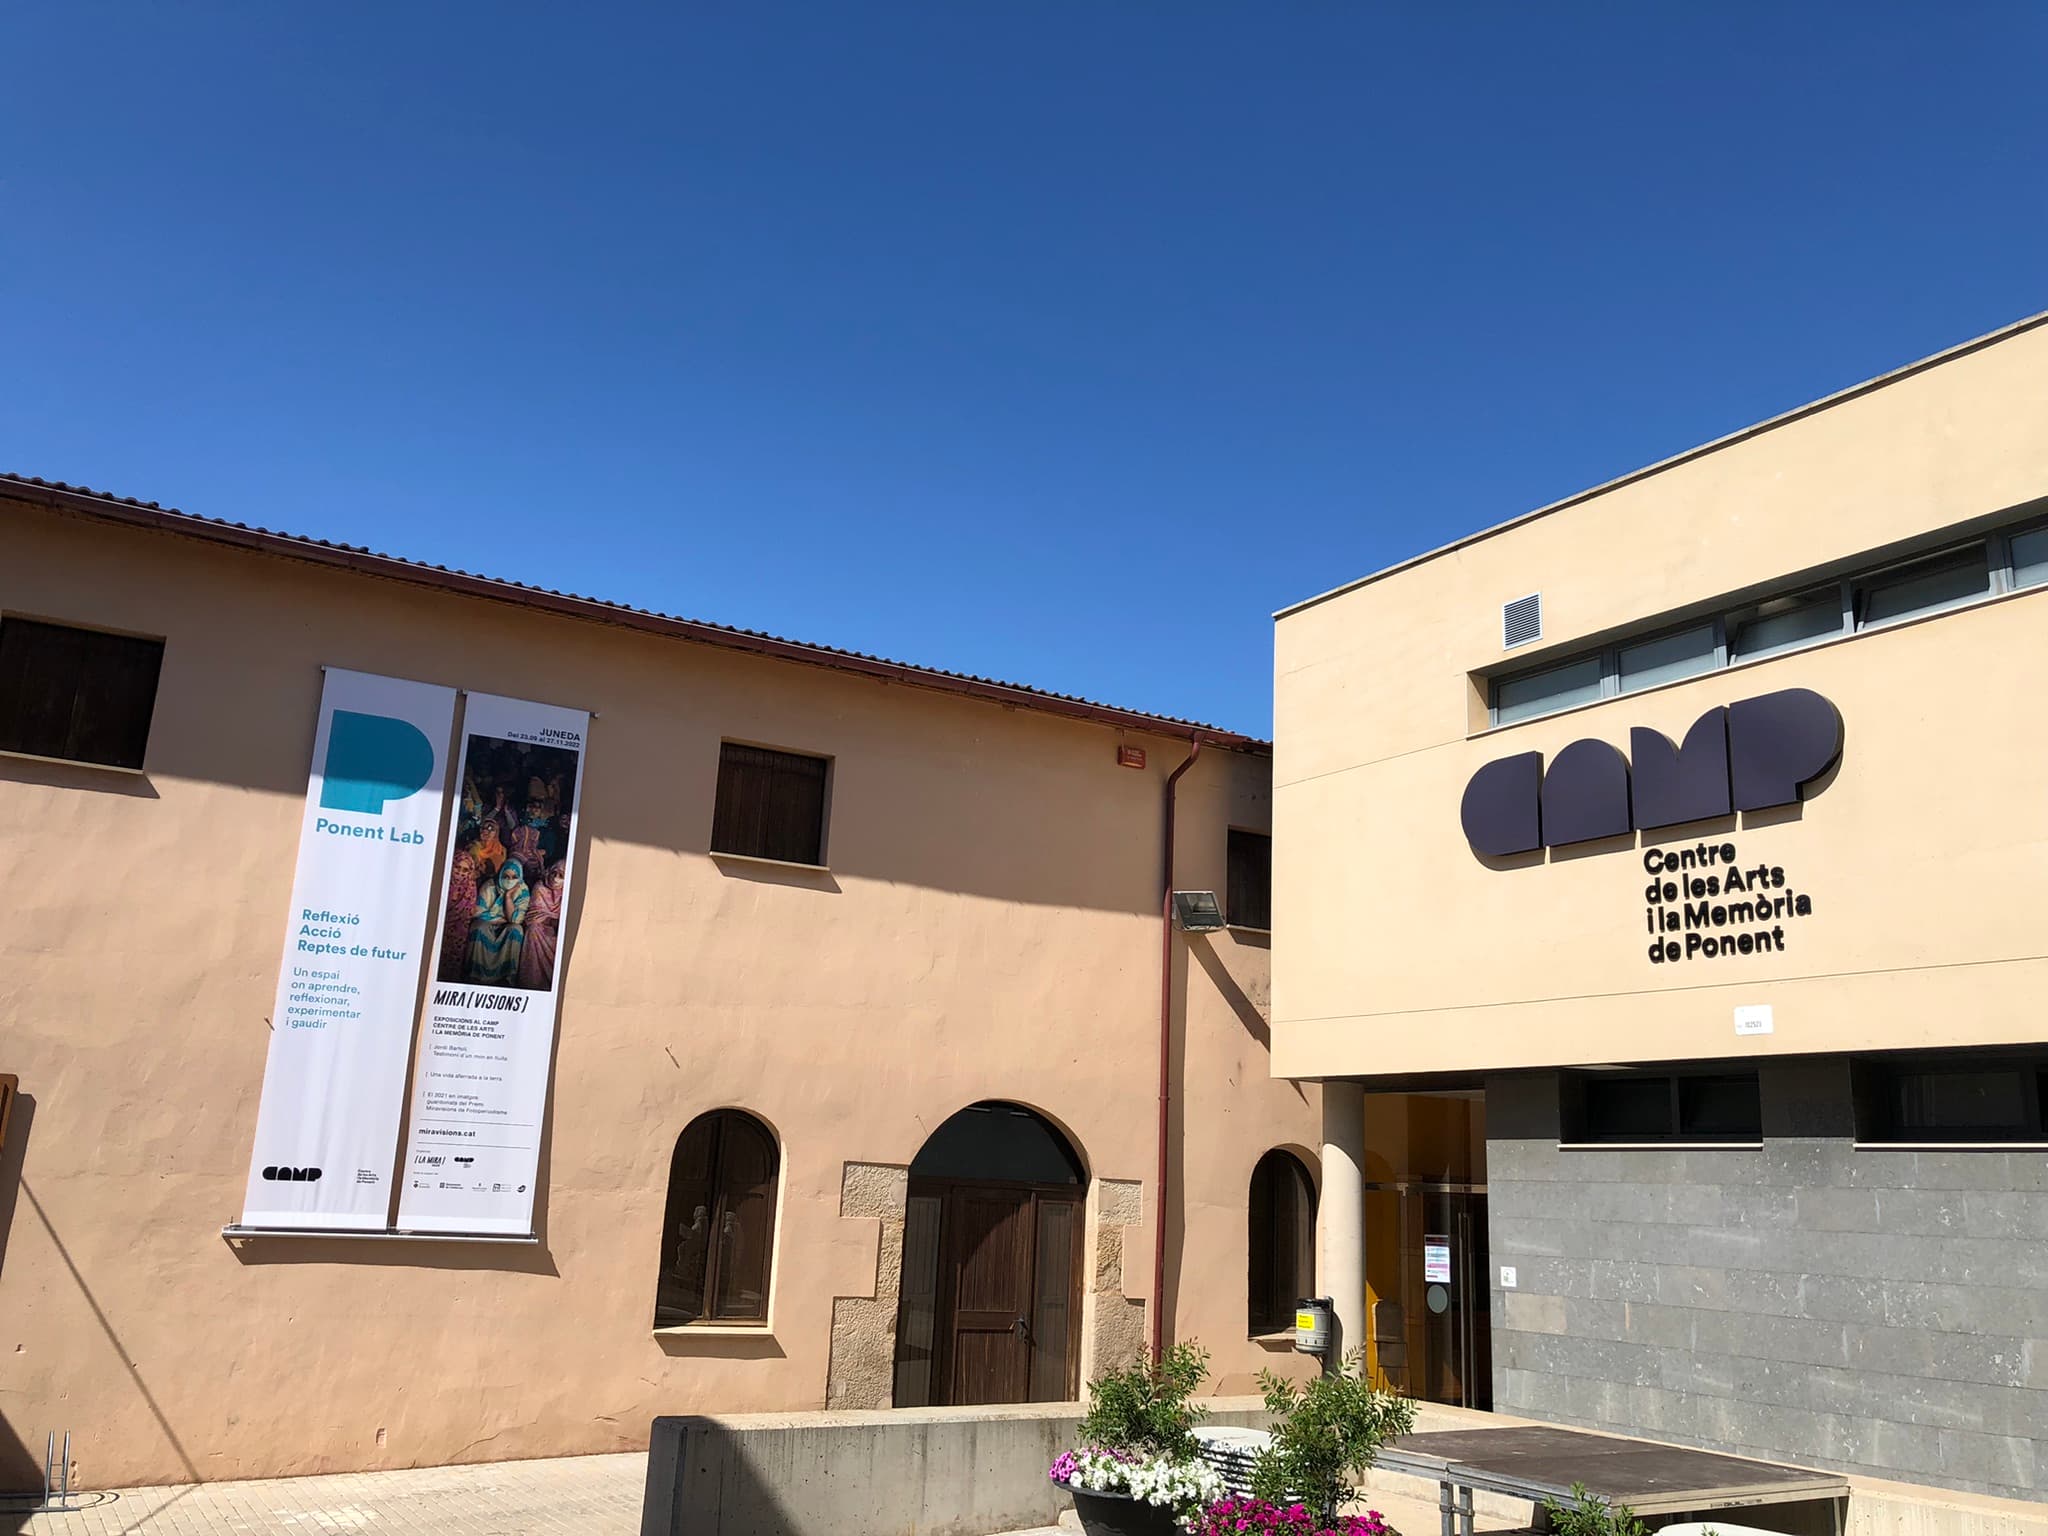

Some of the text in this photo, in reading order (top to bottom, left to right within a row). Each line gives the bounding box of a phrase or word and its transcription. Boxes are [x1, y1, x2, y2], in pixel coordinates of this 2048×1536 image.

[540, 728, 580, 741] JUNEDA
[546, 738, 580, 748] 27.11.2022
[316, 818, 424, 845] Ponent Lab
[1643, 842, 1736, 876] Centre
[1645, 864, 1785, 904] de les Arts
[302, 908, 360, 926] Reflexió
[1646, 888, 1812, 934] i la Memòria
[300, 924, 342, 939] Acció
[298, 940, 407, 960] Reptes de futur
[1648, 925, 1785, 964] de Ponent
[294, 967, 340, 981] Un espai
[291, 981, 360, 995] on aprendre,
[289, 992, 350, 1006] reflexionar,
[288, 1006, 361, 1019] experimentar
[292, 1018, 327, 1029] gaudir
[434, 1016, 473, 1024] EXPOSICIONS
[418, 1128, 476, 1137] miravisions.cat
